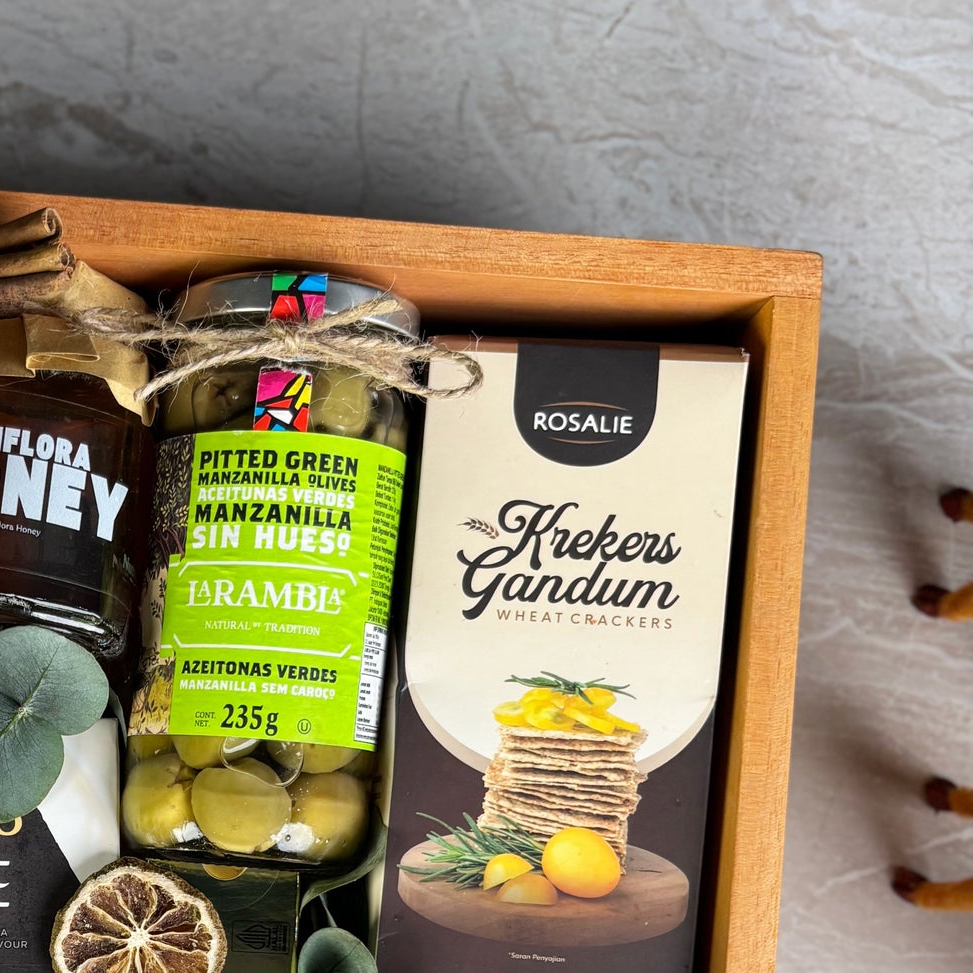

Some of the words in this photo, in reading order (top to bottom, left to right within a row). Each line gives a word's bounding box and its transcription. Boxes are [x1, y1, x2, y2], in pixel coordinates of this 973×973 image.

[533, 412, 633, 434] ROSALIE
[199, 450, 277, 470] PITTED
[285, 451, 359, 478] GREEN
[198, 471, 300, 486] MANZANILLA
[308, 474, 356, 492] OLIVES
[197, 486, 288, 502] ACEITUNAS
[292, 488, 356, 509] VERDES
[194, 502, 352, 531] MANZANILLA
[16, 524, 42, 537] Honey
[192, 524, 241, 549] SIN
[254, 525, 351, 557] HUESO
[498, 500, 682, 571] Krekers
[456, 546, 681, 620] Gandum
[205, 620, 250, 630] NATURAL
[264, 622, 321, 636] TRADITION
[496, 609, 562, 624] WHEAT
[570, 613, 673, 630] CRACKERS
[181, 660, 272, 678] AZEITONAS
[277, 664, 338, 683] VERDES
[179, 680, 257, 693] MANZANILLA
[261, 682, 288, 695] SEM
[194, 711, 216, 719] CONT.
[220, 703, 279, 736] 235g
[0, 928, 8, 937] A
